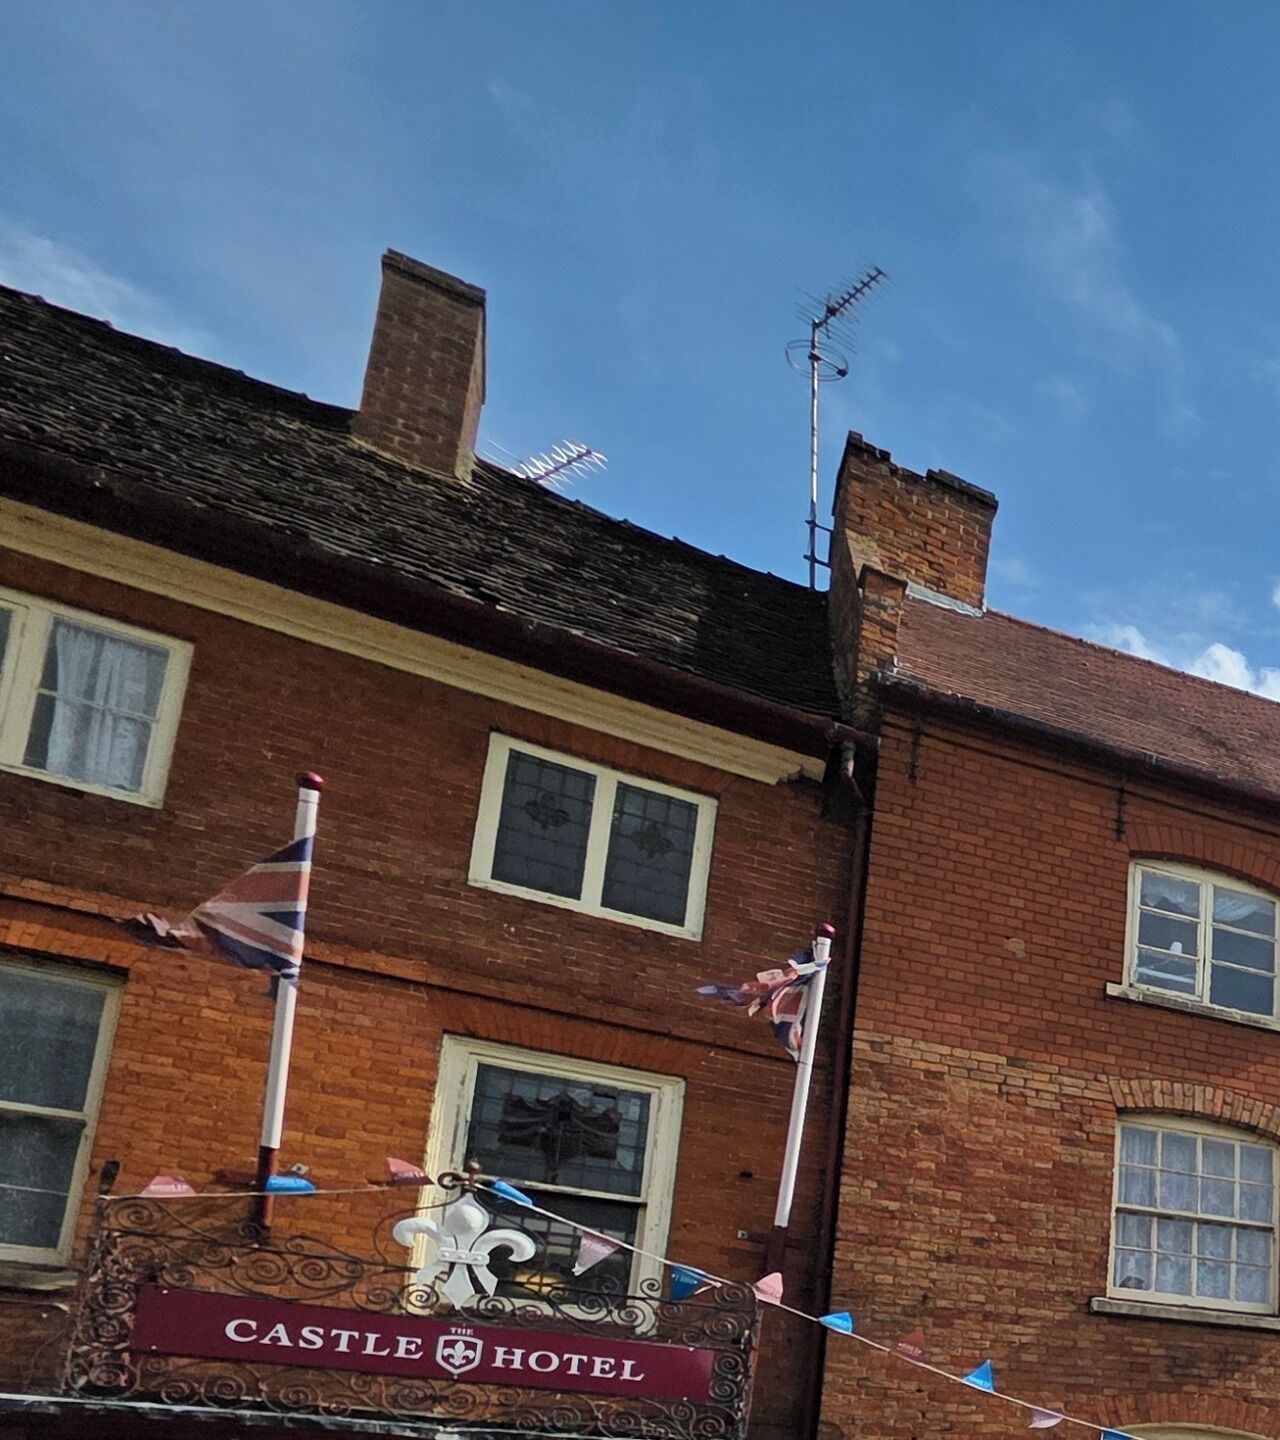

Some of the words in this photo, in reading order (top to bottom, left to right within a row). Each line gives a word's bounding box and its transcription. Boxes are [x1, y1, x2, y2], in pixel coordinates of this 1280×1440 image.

[450, 1327, 474, 1336] THE
[224, 1319, 424, 1360] CASTLE
[491, 1346, 645, 1382] HOTEL
